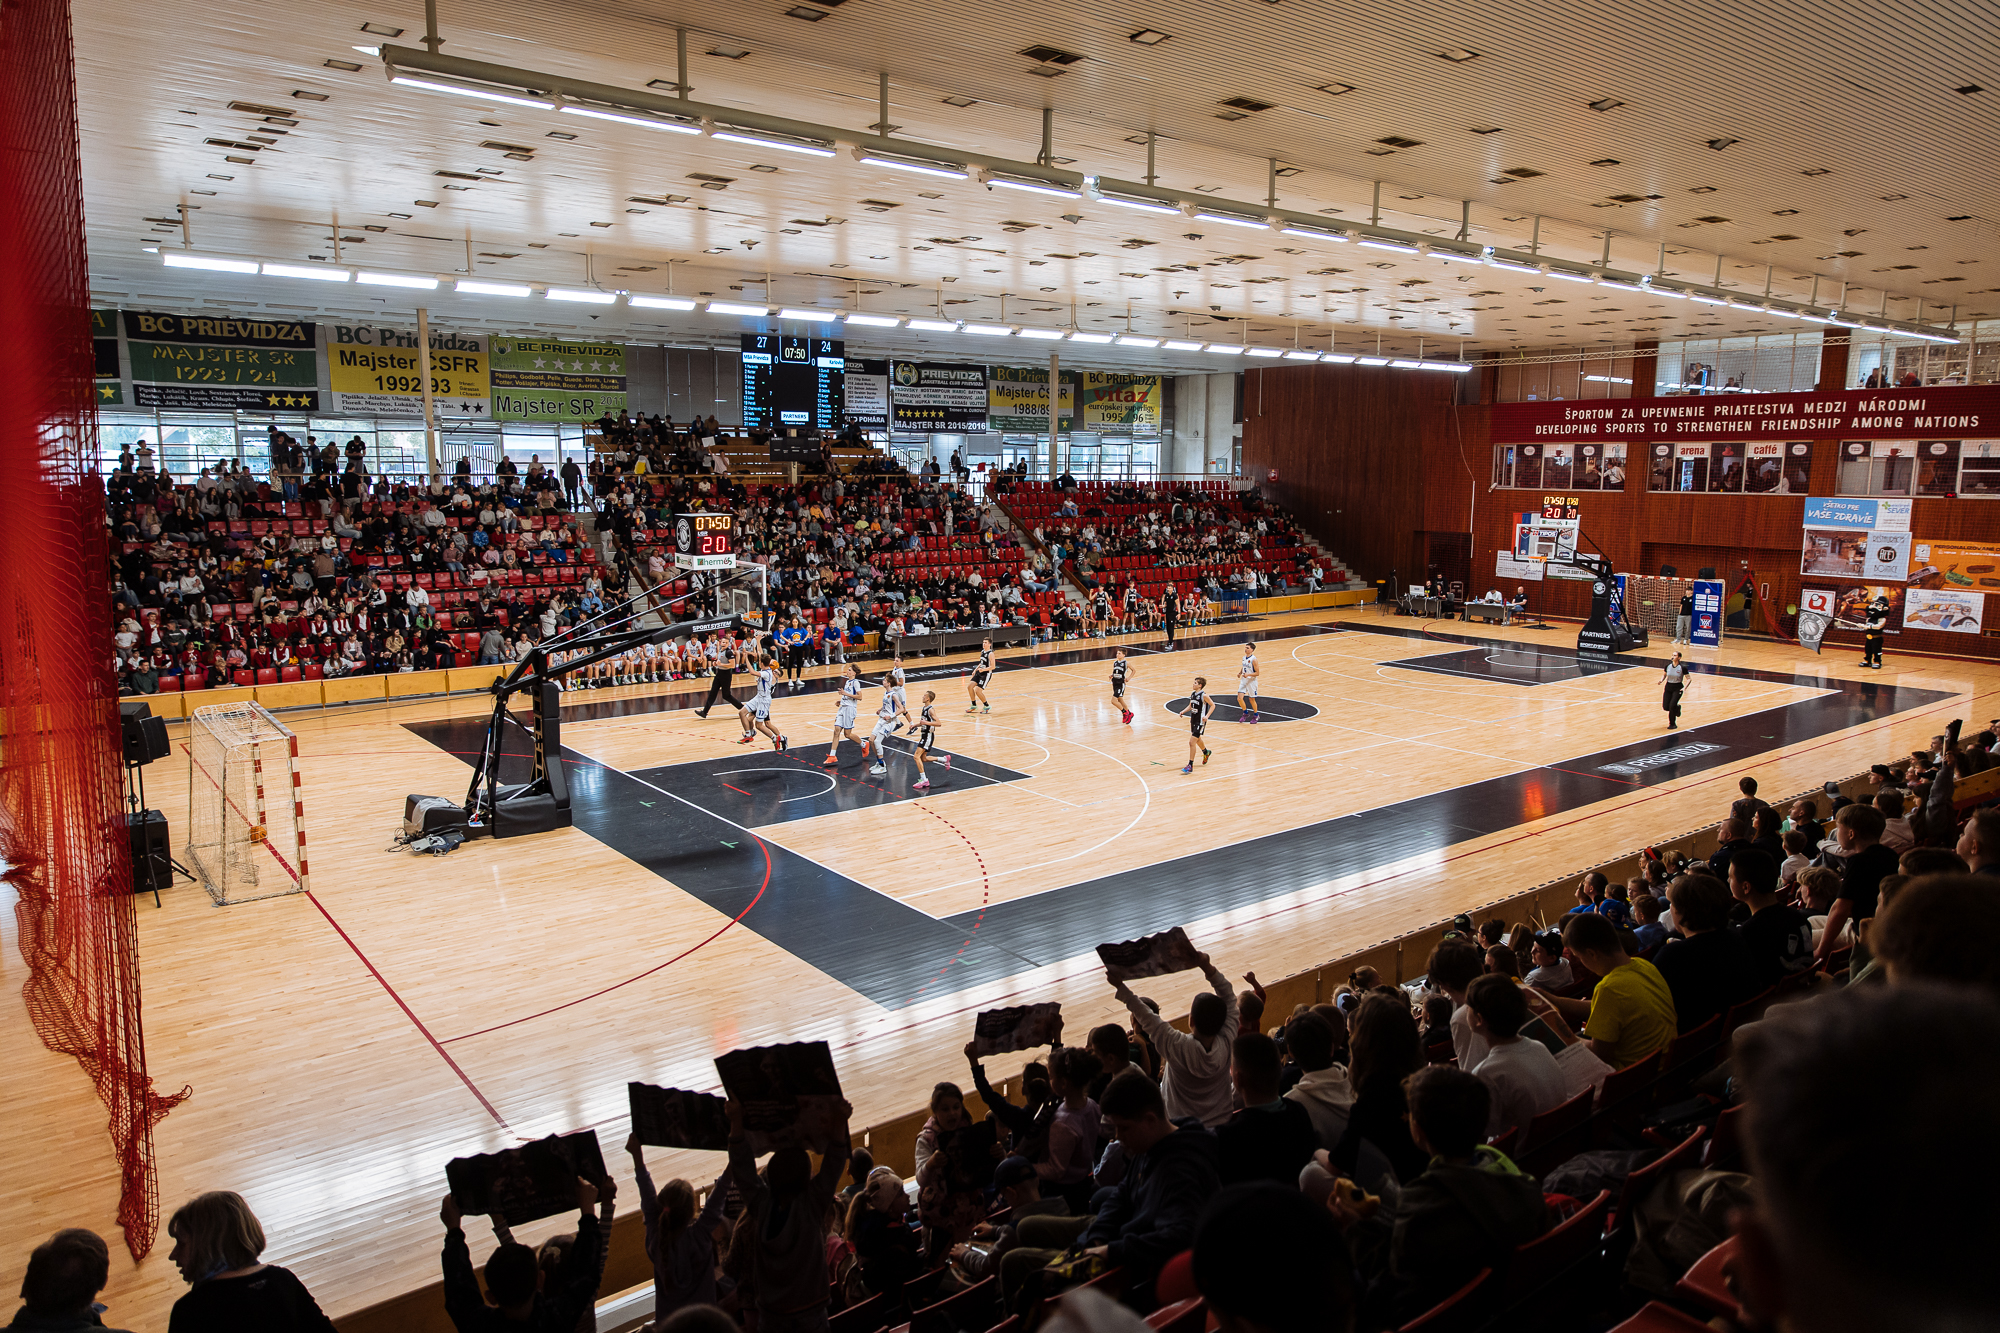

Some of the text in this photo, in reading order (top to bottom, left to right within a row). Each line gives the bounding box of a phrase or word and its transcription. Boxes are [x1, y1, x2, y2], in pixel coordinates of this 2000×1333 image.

[138, 315, 306, 341] BC PRIEVIDZA
[335, 325, 372, 345] BC
[757, 336, 767, 348] 27
[793, 338, 797, 347] 3
[821, 341, 831, 353] 24
[152, 345, 296, 366] MAJSTER SR
[516, 342, 622, 357] BC PRIEVIDZA
[785, 348, 805, 359] 07:50
[339, 350, 417, 372] Majster
[774, 355, 778, 364] 0
[811, 358, 815, 366] 0
[172, 365, 226, 382] 1993
[249, 369, 277, 383] 94
[921, 369, 983, 381] PRIEVIDZA
[997, 368, 1069, 384] BC Prieviza
[1089, 372, 1157, 386] BC PRIEVIDZA
[375, 375, 451, 394] 199293
[996, 384, 1068, 400] Majster ČSR
[1093, 385, 1149, 403] víťaz
[496, 395, 596, 418] Majster SR
[600, 396, 623, 405] 2011
[1088, 403, 1155, 413] európskej superligy
[1564, 396, 1926, 420] ŠPORTOM ZA UPEVNENIE PRIATEĽSTVA MEDZI NÁRODMI
[859, 415, 886, 424] POHÁRA
[1101, 412, 1123, 422] 1995
[1133, 413, 1144, 423] 96
[894, 420, 933, 429] MAJSTER
[935, 421, 946, 429] SR
[947, 421, 986, 430] 2015/2016
[1535, 415, 1979, 435] DEVELOPING SPORTS TO STRENGTHEN FRIENDSHIP AMONG NATIONS
[1680, 446, 1705, 455] arena
[1753, 444, 1777, 455] caffé
[1544, 496, 1565, 506] 07:50
[1823, 500, 1847, 510] VŠETKO
[1545, 507, 1561, 518] 20
[1808, 508, 1832, 519] VAŠE
[1833, 512, 1873, 524] ZDRAVIE
[696, 516, 731, 530] 07:50
[702, 536, 726, 553] 20
[692, 621, 732, 633] SPORT SYSTEM
[1582, 630, 1611, 639] PARTNERS
[1626, 743, 1720, 768] PRIEVIDZA
